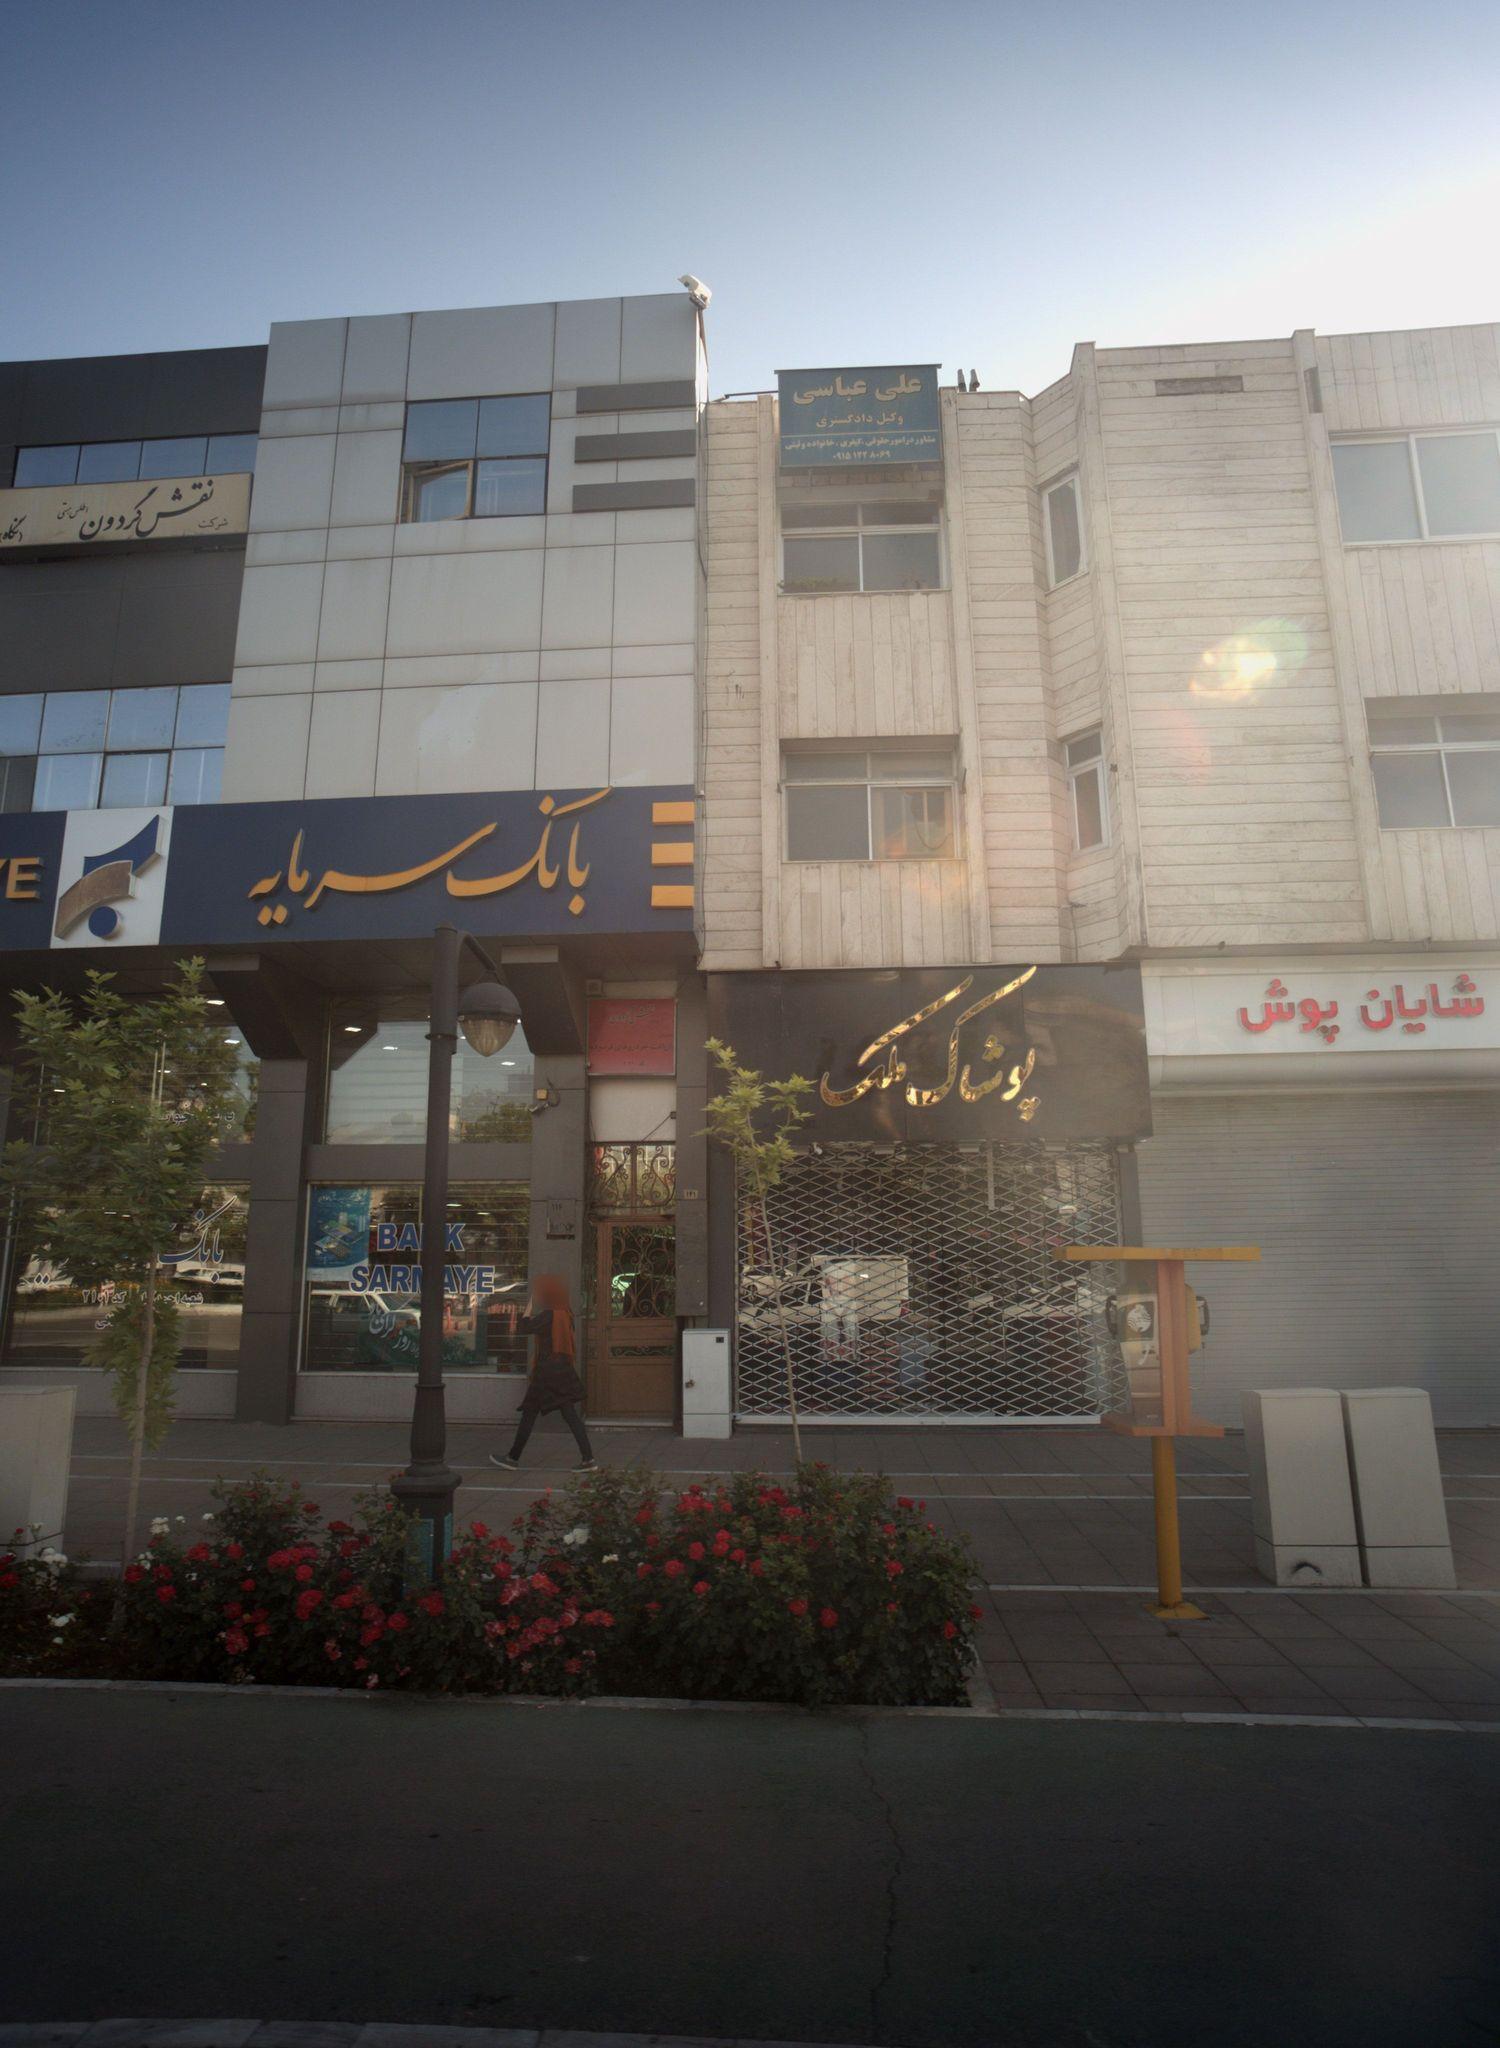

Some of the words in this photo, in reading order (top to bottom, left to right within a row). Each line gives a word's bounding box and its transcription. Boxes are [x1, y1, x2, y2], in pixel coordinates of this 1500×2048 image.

[793, 375, 867, 405] عباسی
[875, 373, 922, 402] علی
[816, 412, 873, 428] دادگستری
[877, 411, 904, 425] وکیل
[137, 479, 214, 538] نقش
[198, 516, 229, 530] شرکت
[446, 787, 613, 915] بانک
[0, 857, 43, 899] E
[248, 823, 498, 926] سرمایه
[1238, 979, 1341, 1044] پوش
[1359, 974, 1485, 1033] شایان
[905, 965, 1041, 1121] پوشاک
[157, 1195, 238, 1284] بانک
[377, 1222, 466, 1251] BAK
[180, 1292, 203, 1308] شعبه
